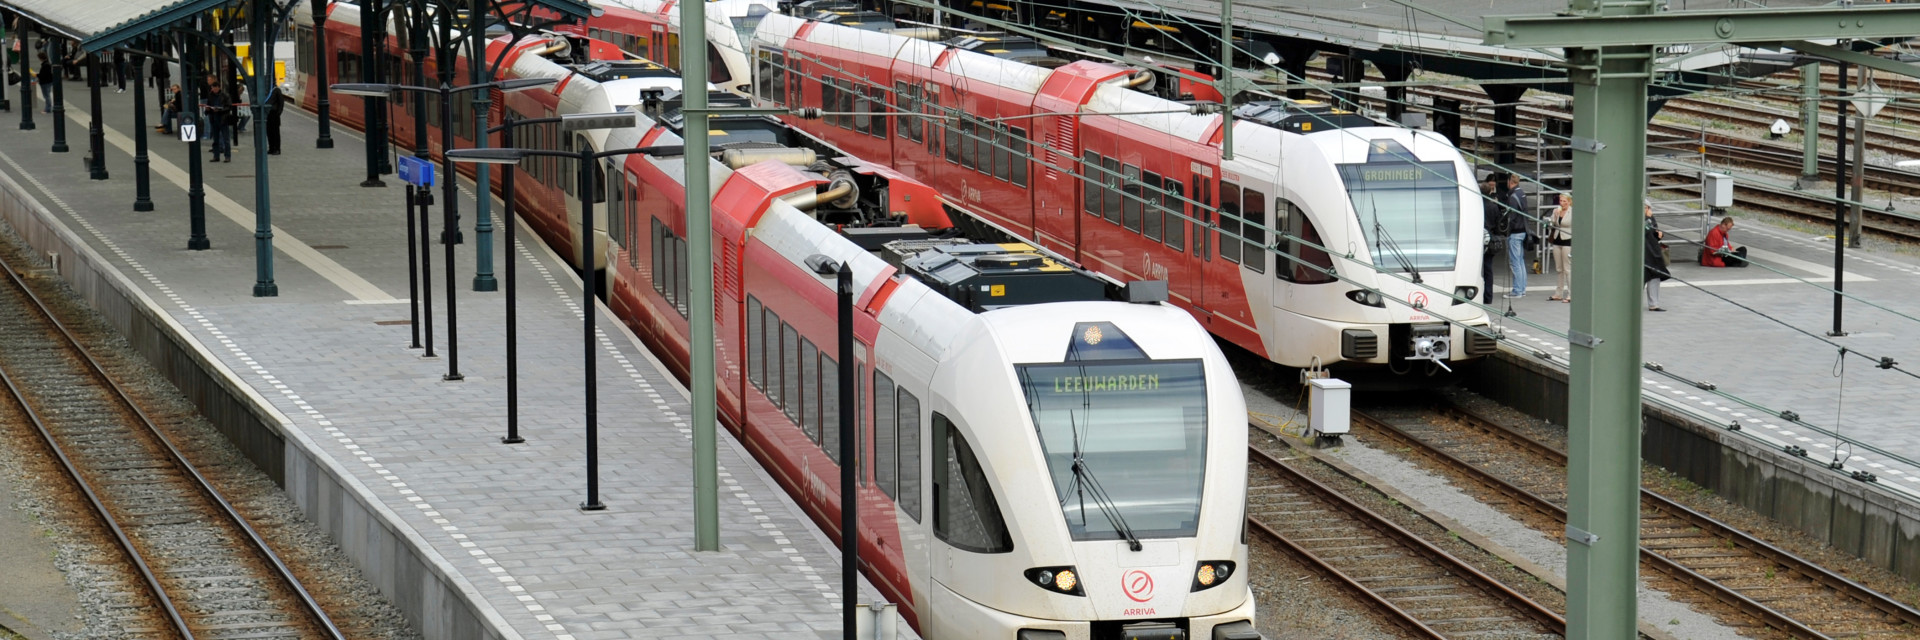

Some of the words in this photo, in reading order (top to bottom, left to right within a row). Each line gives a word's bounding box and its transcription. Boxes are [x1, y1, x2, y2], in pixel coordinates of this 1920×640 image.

[183, 126, 194, 140] V
[1365, 169, 1422, 181] GRONINGEN
[1055, 374, 1159, 393] LEEUWARDEN
[1123, 608, 1156, 616] ARRIVA
